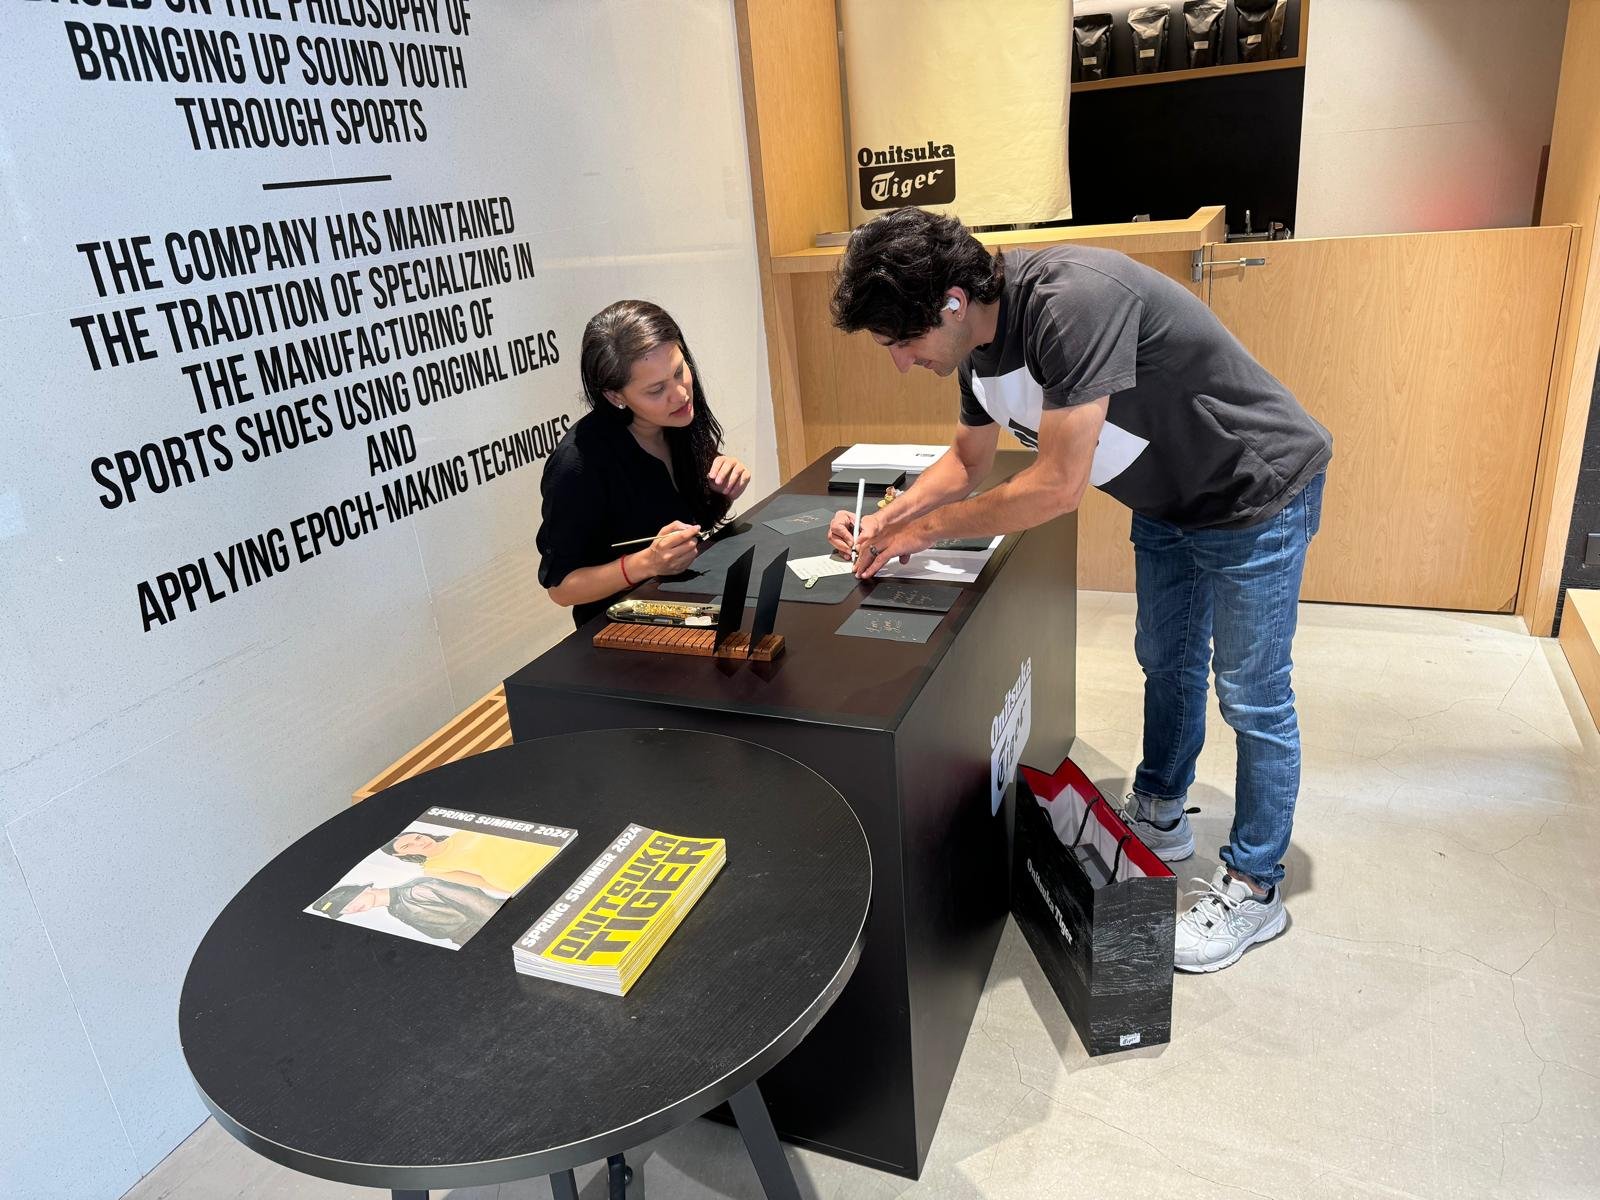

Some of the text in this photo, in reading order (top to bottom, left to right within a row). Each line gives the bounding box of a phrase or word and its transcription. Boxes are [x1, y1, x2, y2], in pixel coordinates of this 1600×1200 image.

[63, 20, 468, 89] BRINGING UP SOUND YOUTH
[174, 97, 428, 151] THROUGH SPORTS
[857, 141, 955, 167] Onitsuka
[870, 169, 944, 202] Tiger
[75, 196, 515, 298] THE COMPANY HAS MAINTAINED
[69, 241, 535, 371] THE TRADITION OF SPECIALIZING IN
[180, 297, 494, 415] THE MANUFACTURING OF
[90, 329, 564, 510] SPORTS SHOES USING ORIGINAL IDEAS
[366, 423, 417, 477] AND
[136, 413, 570, 633] APPLYING EPOCH-MAKING TECHNIQUES
[990, 656, 1032, 750] Onitsuka
[997, 699, 1027, 791] Tiger
[427, 807, 570, 839] SPRING SUMMER 2024
[521, 826, 643, 948] SPRING SUMMER 2024
[550, 835, 679, 959] ONITSUKA
[575, 839, 718, 961] TIGER
